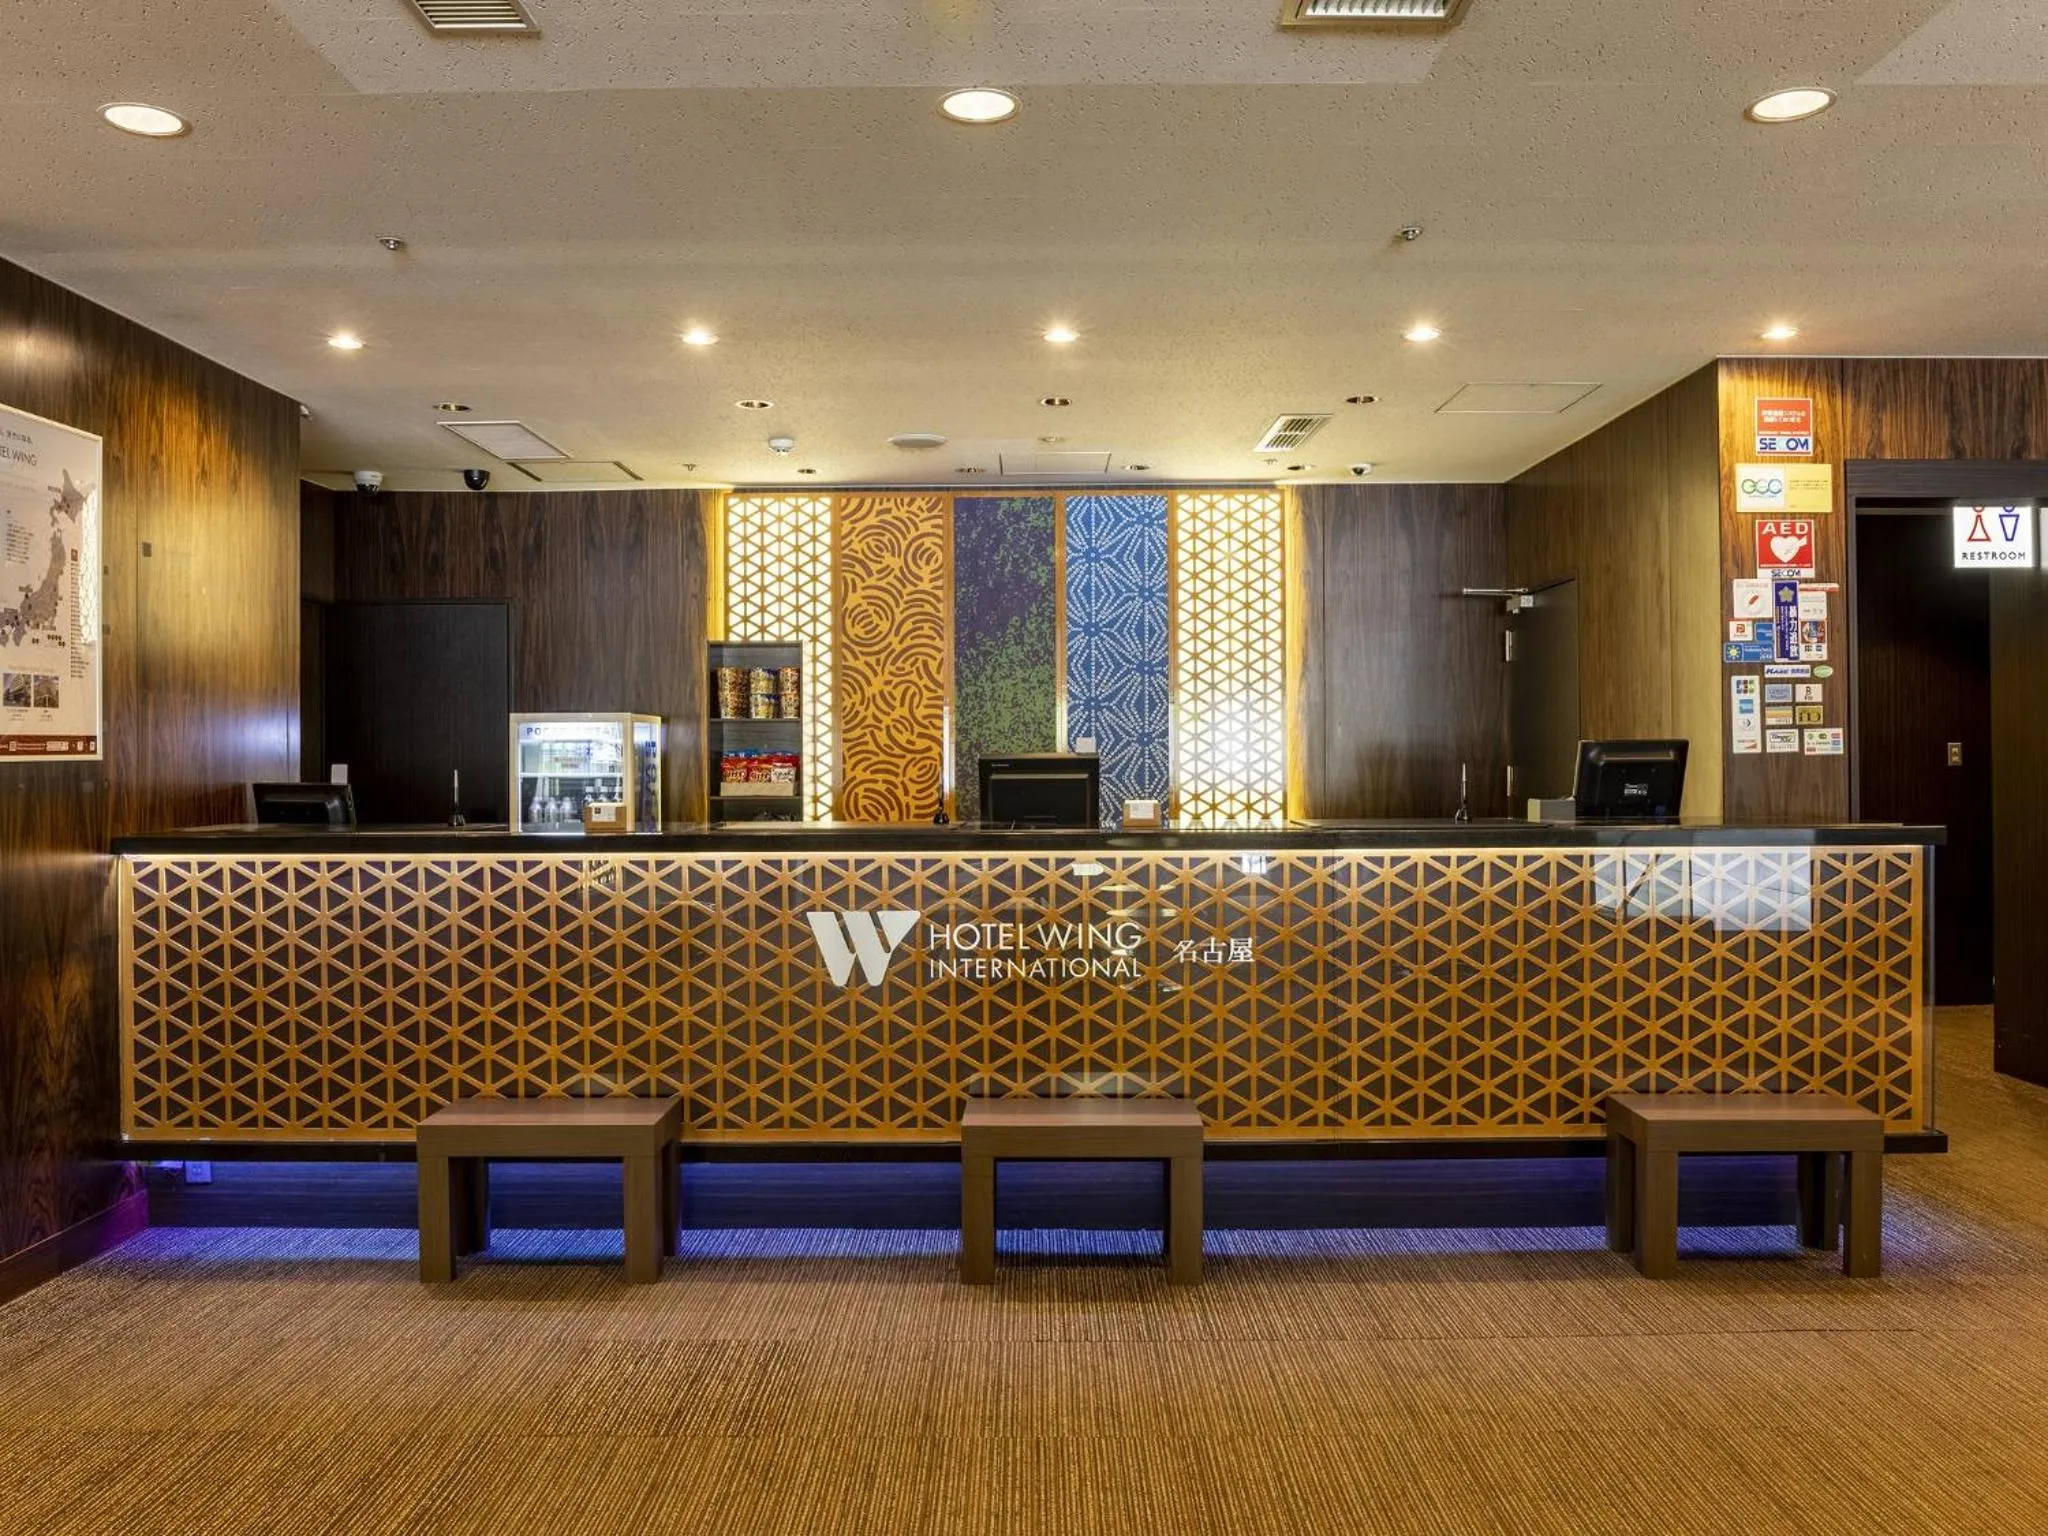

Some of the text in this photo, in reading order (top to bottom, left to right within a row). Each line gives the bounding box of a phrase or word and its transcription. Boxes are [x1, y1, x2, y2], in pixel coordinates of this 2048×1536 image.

[12, 449, 37, 467] WING
[1762, 522, 1809, 535] AED
[1961, 551, 2026, 561] RESTROOM
[929, 922, 1142, 951] HOTEL WING
[1172, 937, 1255, 964] 名古屋
[929, 957, 1142, 979] INTERNATIONAL
